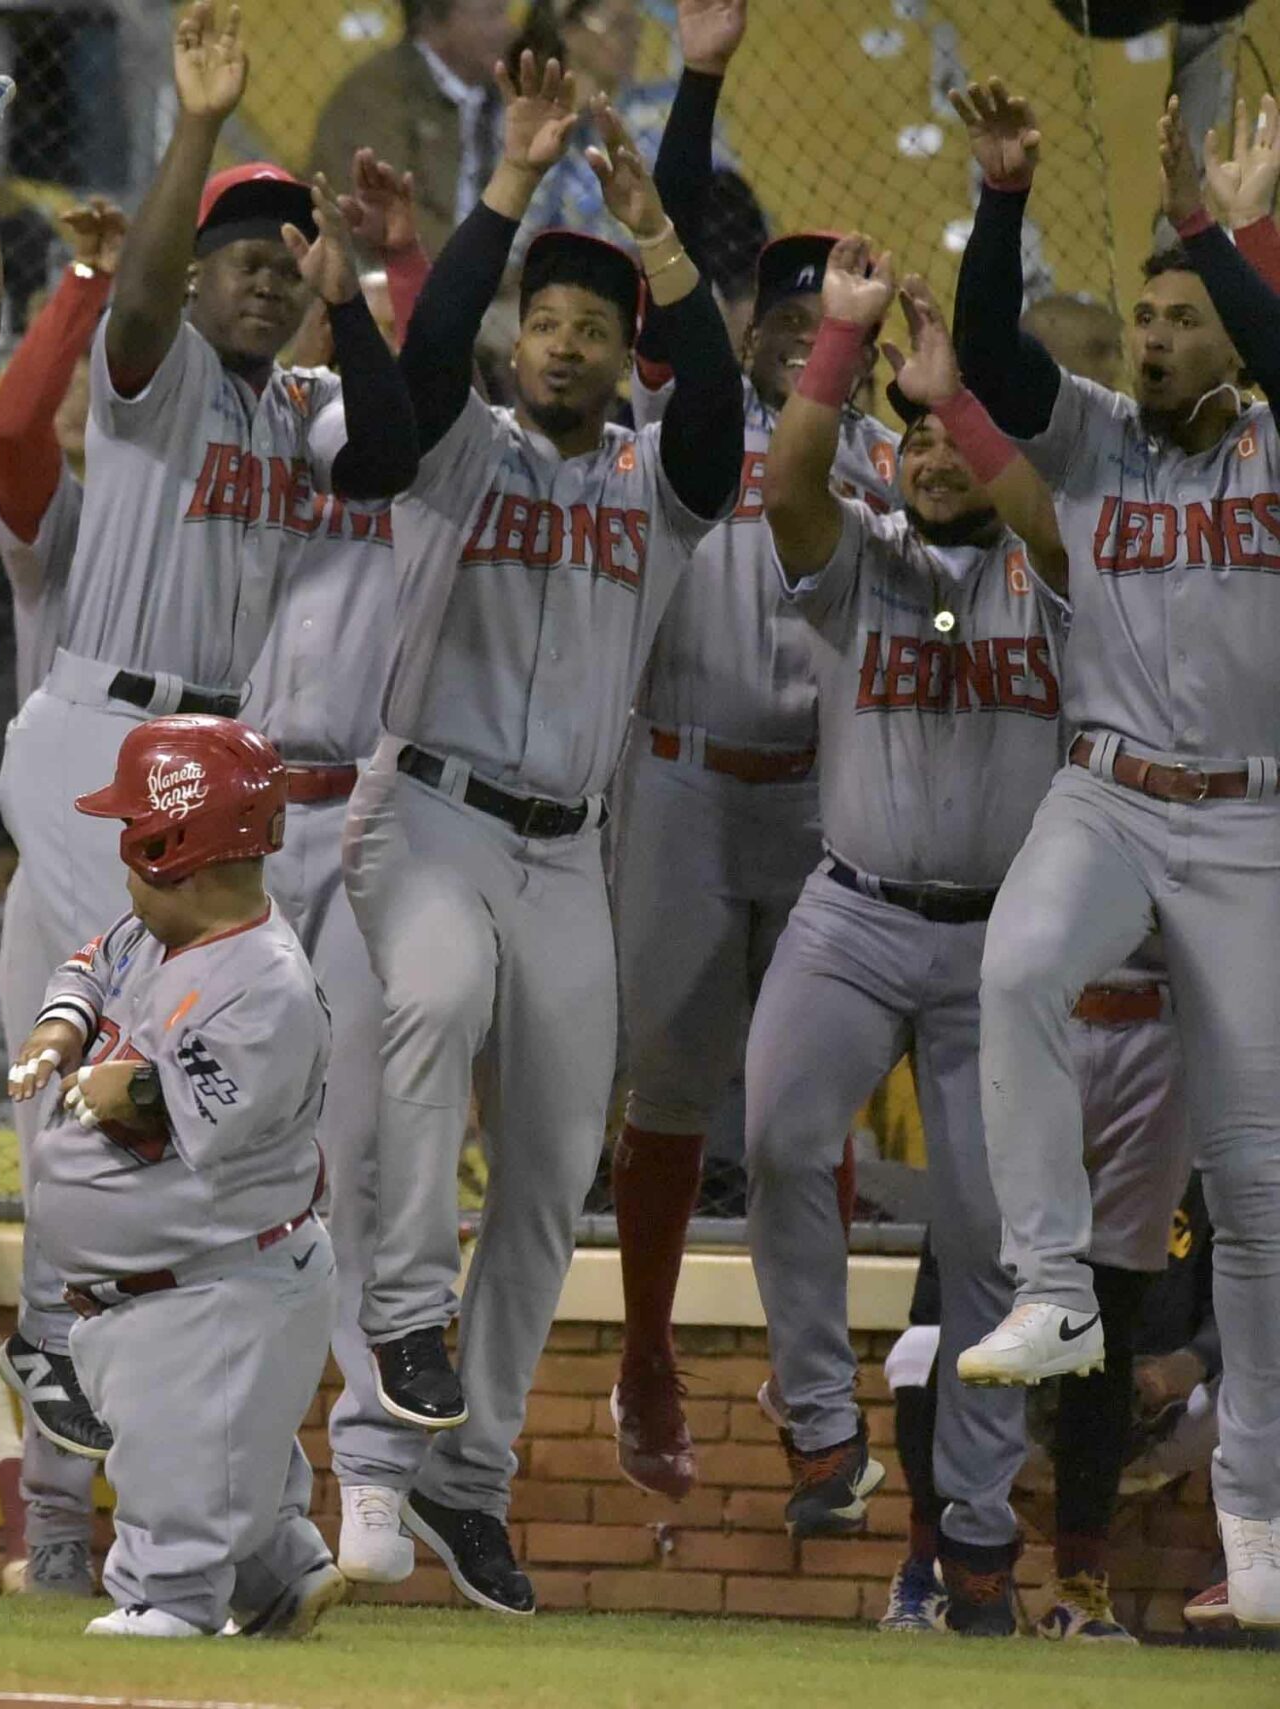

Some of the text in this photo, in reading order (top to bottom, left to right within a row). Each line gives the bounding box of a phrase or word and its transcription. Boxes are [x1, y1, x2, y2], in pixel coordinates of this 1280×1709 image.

[458, 489, 650, 594] LEONES
[1093, 492, 1280, 577] LEONES
[855, 630, 1060, 720] LEONES
